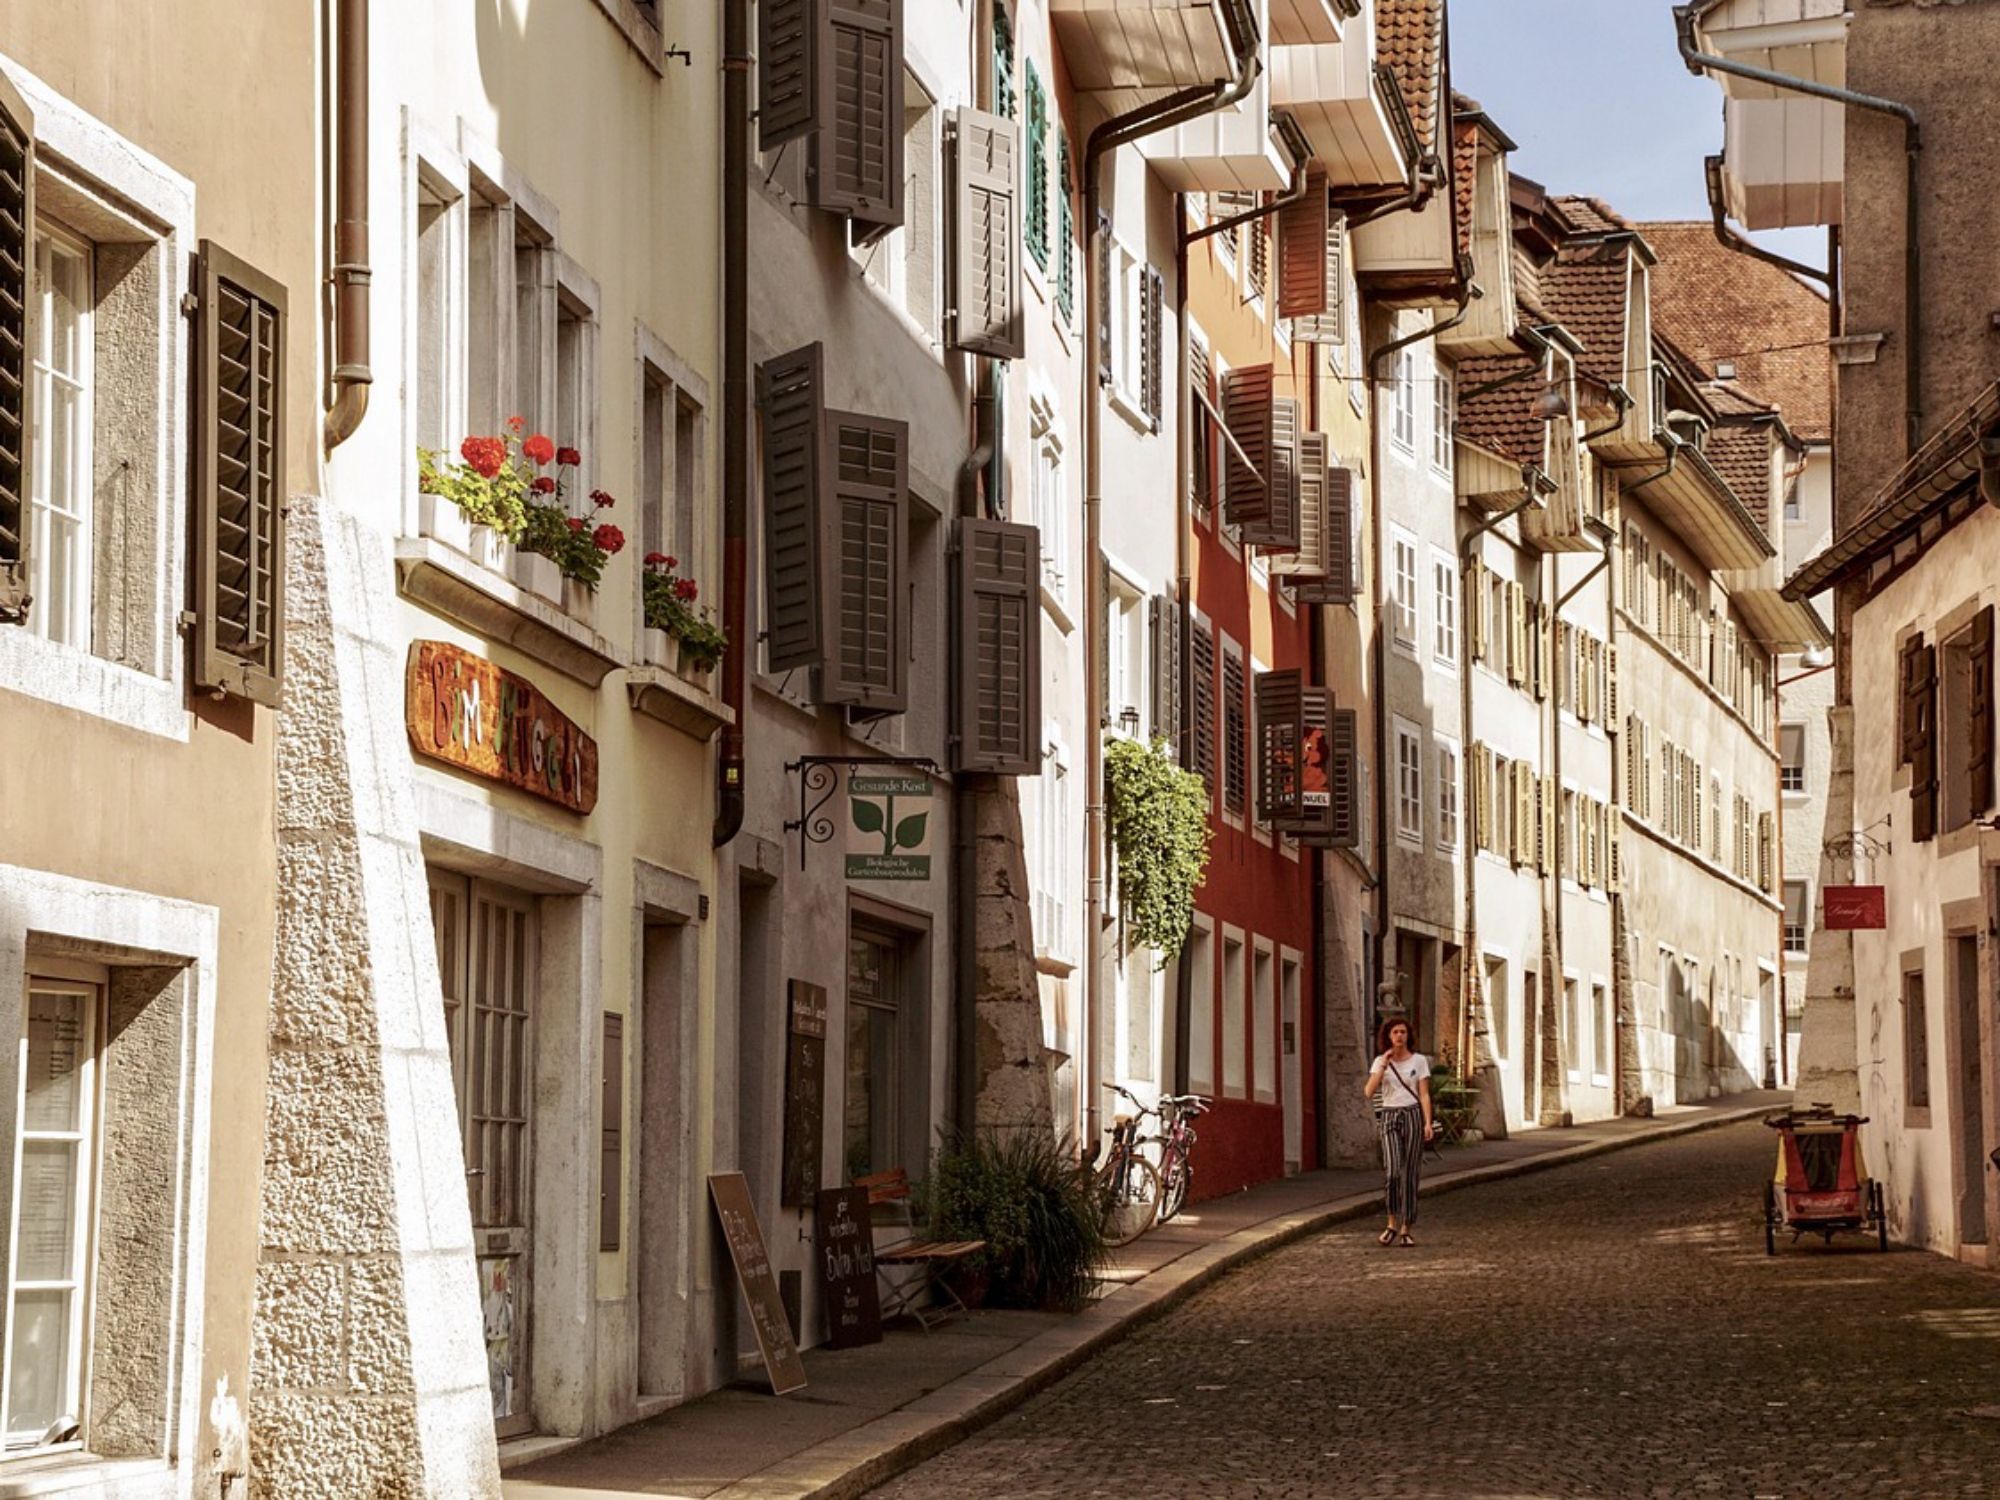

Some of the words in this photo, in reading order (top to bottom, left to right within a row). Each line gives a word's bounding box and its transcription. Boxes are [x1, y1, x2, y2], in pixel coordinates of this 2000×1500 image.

[852, 780, 900, 792] Gesunde
[902, 780, 926, 792] Kost
[866, 857, 909, 868] Biologische
